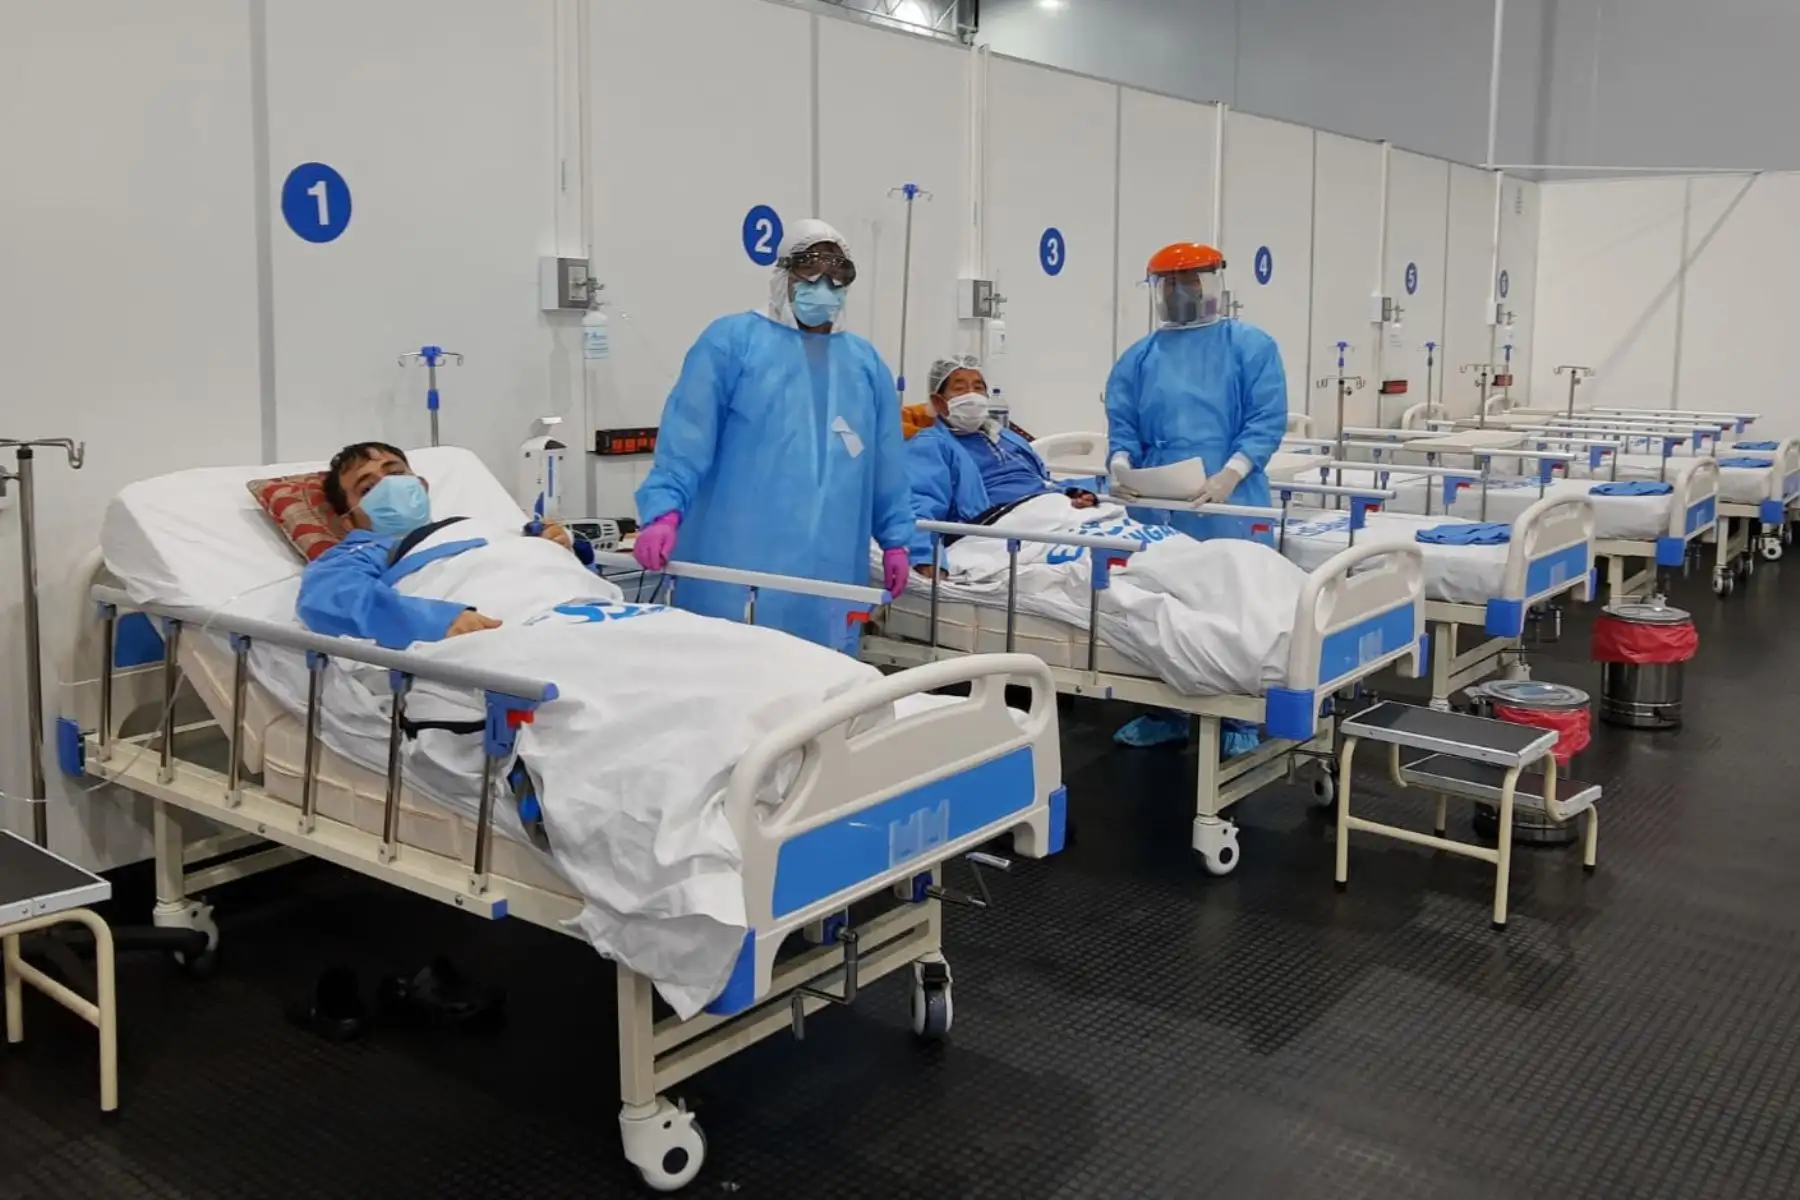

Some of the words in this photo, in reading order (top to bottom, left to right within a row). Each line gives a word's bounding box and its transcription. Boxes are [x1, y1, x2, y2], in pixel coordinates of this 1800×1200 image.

[307, 180, 329, 226] 1
[755, 218, 773, 254] 2
[1047, 238, 1059, 266] 3
[1259, 254, 1268, 276] 4
[1409, 269, 1415, 286] 5
